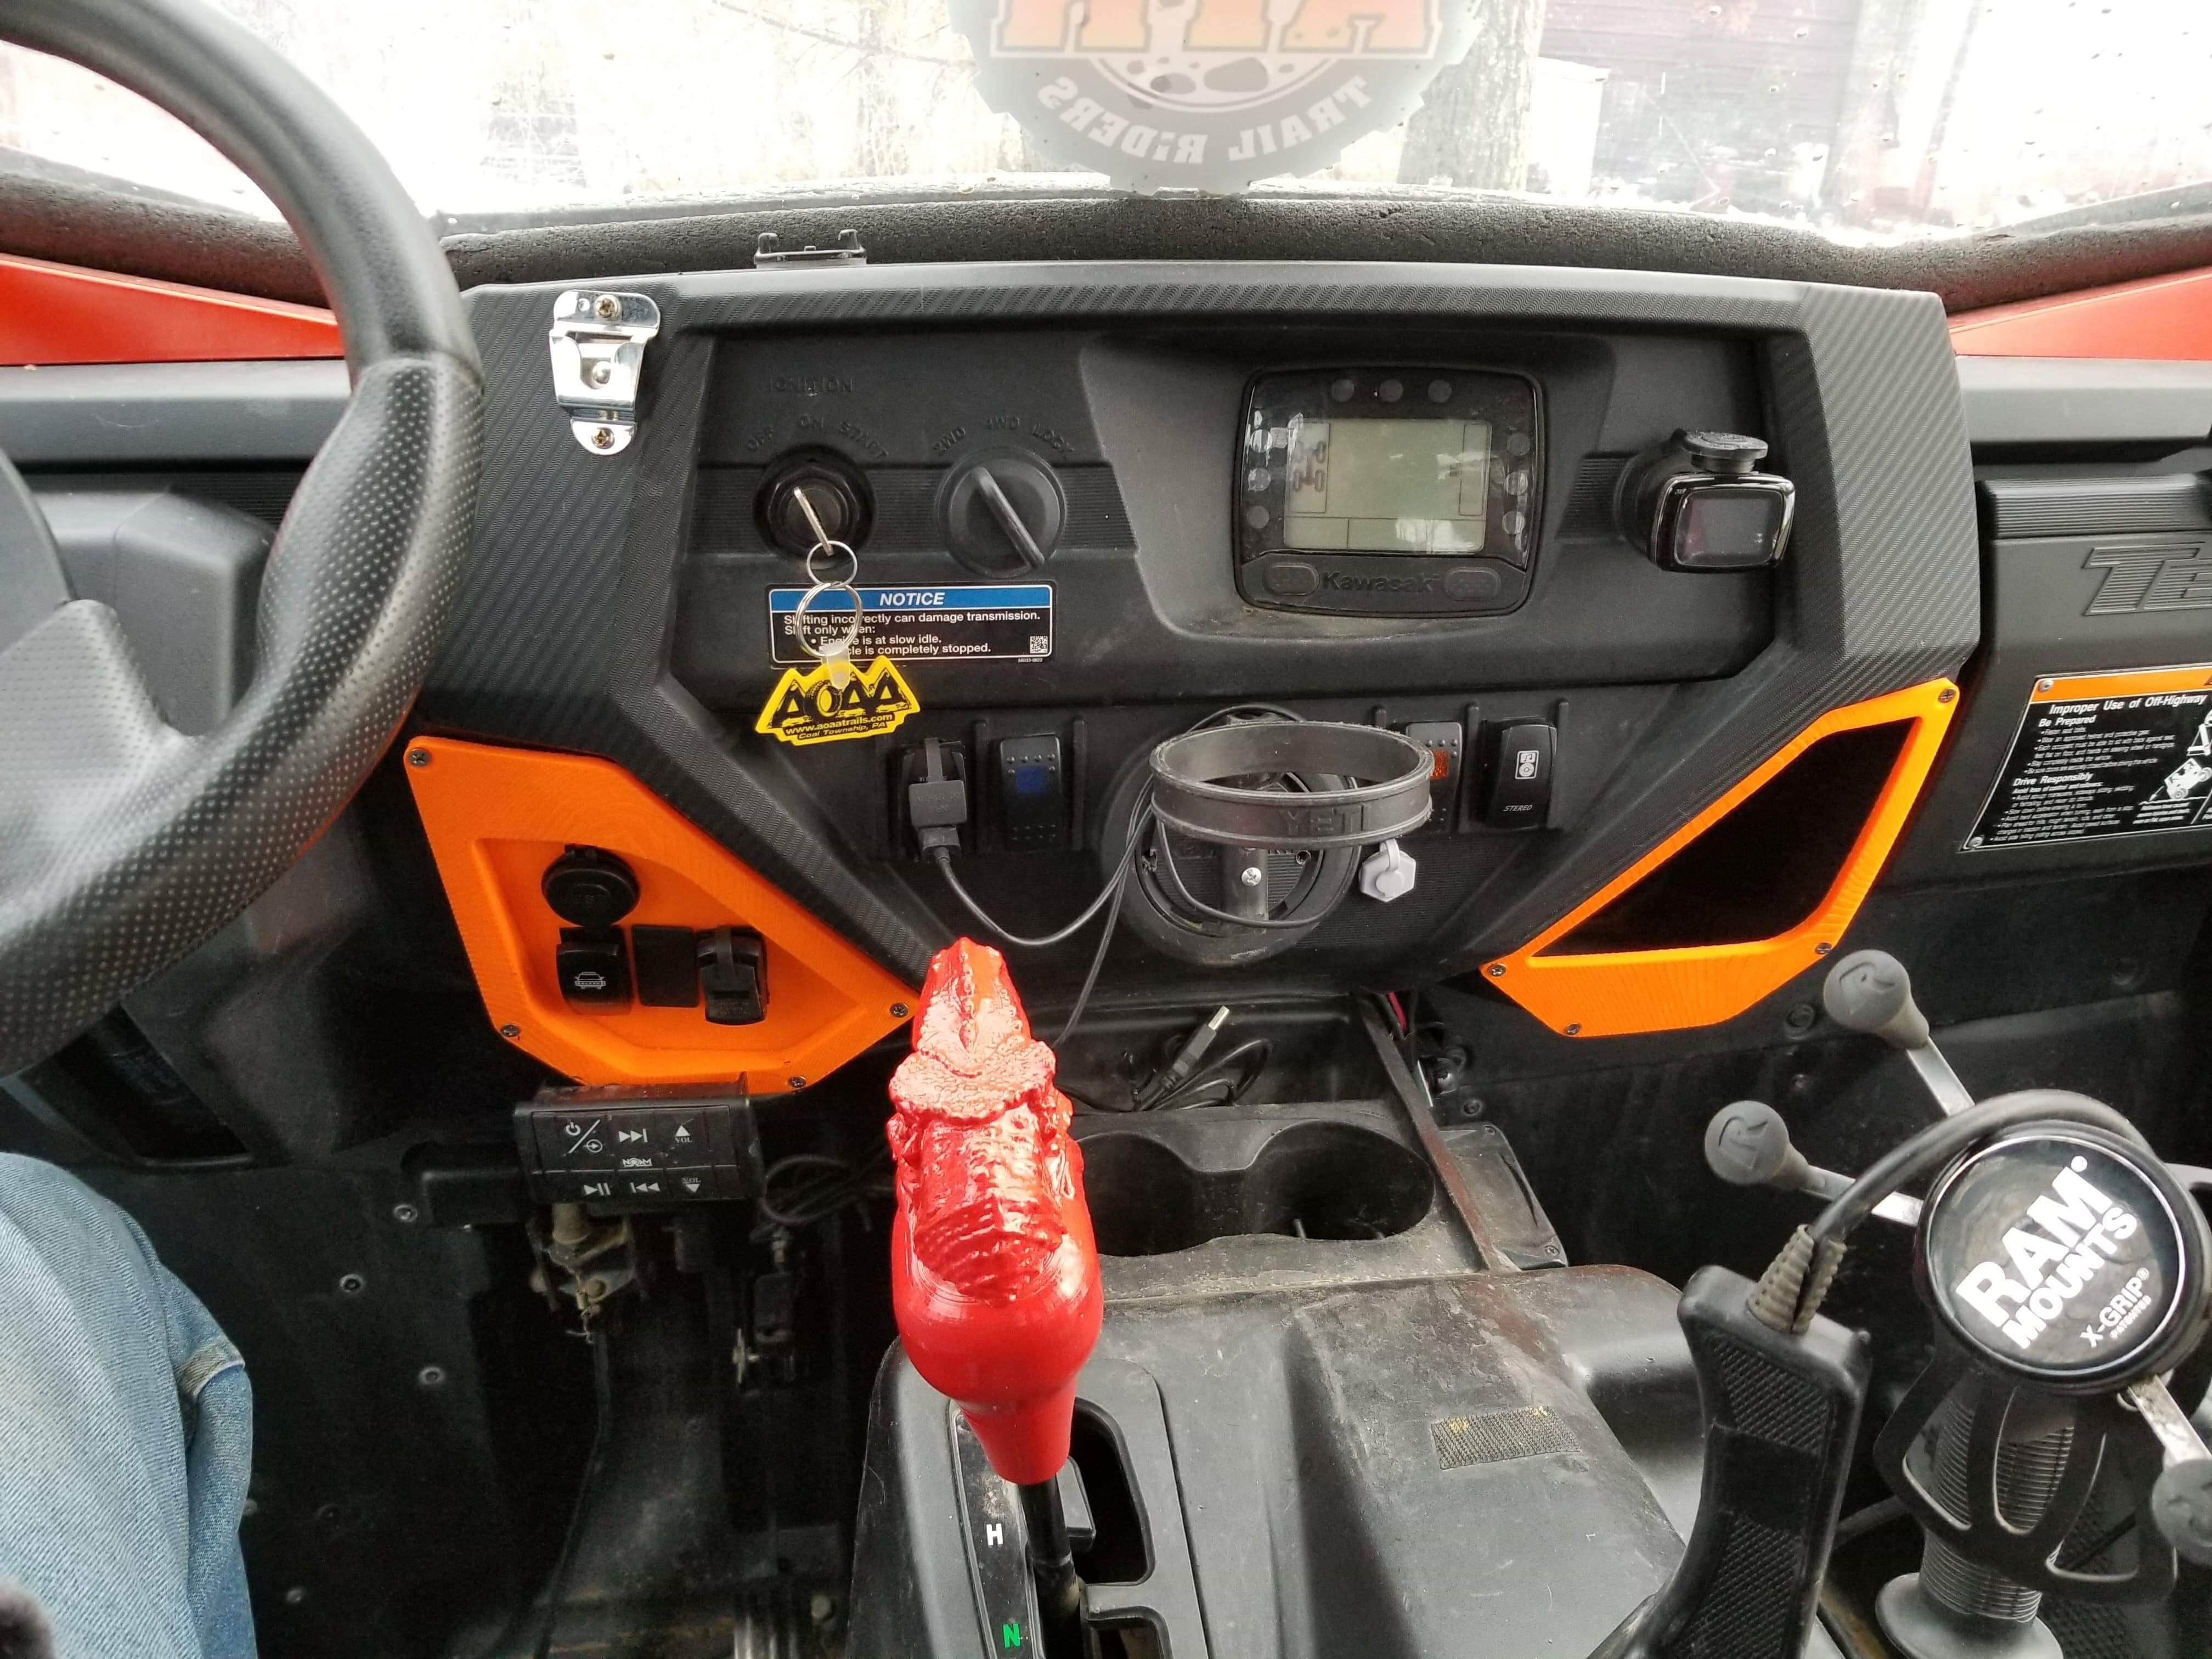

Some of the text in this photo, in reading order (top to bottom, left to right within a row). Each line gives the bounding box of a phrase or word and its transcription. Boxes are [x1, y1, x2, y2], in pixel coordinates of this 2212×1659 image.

[879, 592, 946, 606] NOTICE
[784, 611, 1041, 625] Sfting incorectly can damage transmission.
[815, 625, 839, 636] only
[862, 635, 872, 645] is
[875, 635, 886, 645] at
[892, 634, 915, 644] slow
[918, 634, 942, 644] idle.
[865, 645, 874, 654] is
[878, 644, 939, 658] completely
[943, 642, 991, 654] stopped.
[766, 669, 912, 729] AOAA
[2049, 694, 2208, 715] Improper Use of Off-Highway
[785, 714, 893, 736] www.aoaatrails.com
[2038, 715, 2097, 727] Be Prepared
[798, 730, 820, 740] Coal
[823, 724, 868, 736] Township,
[2012, 772, 2094, 786] Drive Responsibly
[1279, 804, 1371, 835] YETI
[1956, 1166, 2113, 1328] RAM
[2002, 1206, 2137, 1349] MOUNTS
[987, 1523, 1003, 1545] H
[1003, 1624, 1021, 1647] N
